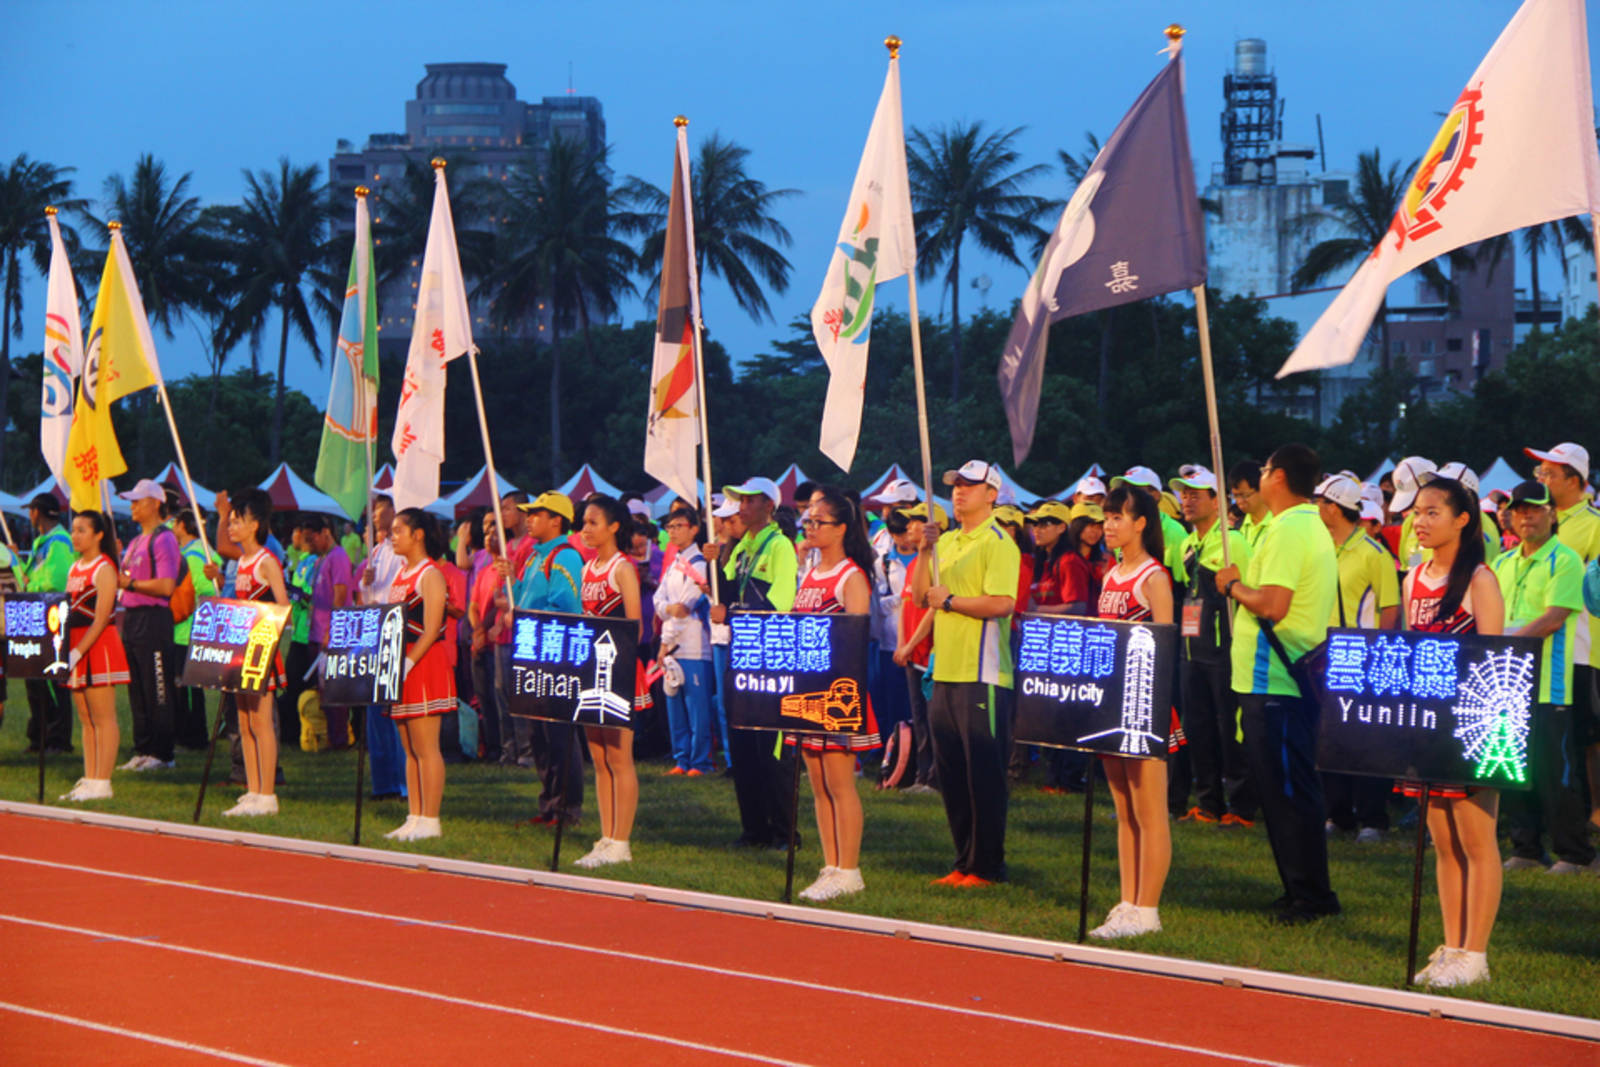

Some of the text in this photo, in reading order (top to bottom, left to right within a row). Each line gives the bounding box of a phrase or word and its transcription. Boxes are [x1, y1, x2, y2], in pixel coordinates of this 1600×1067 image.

[325, 653, 378, 680] Matsu
[512, 617, 595, 667] 臺南市
[730, 614, 832, 672] 嘉義縣
[1018, 619, 1118, 678] 嘉義市
[1326, 633, 1460, 698] 雲林縣
[512, 665, 582, 699] Tainan
[1338, 695, 1438, 730] Yunlin
